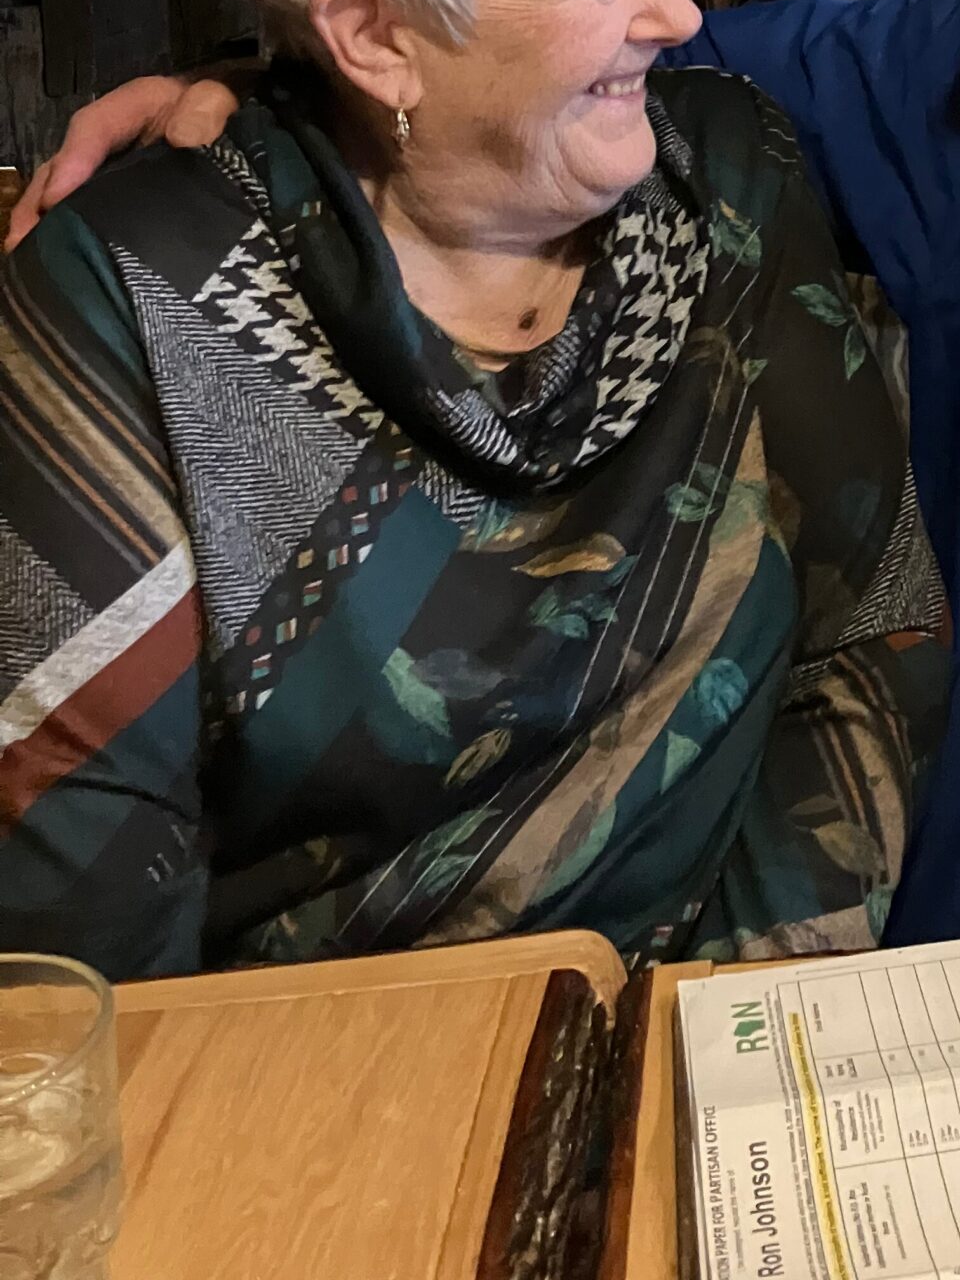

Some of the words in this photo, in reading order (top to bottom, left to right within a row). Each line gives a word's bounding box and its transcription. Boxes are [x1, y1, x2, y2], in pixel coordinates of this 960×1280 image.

[706, 1145, 723, 1203] PARTISAN
[747, 1140, 779, 1237] Johnson
[711, 1204, 725, 1225] FOR
[713, 1226, 729, 1257] PAPER
[757, 1242, 785, 1278] Ron
